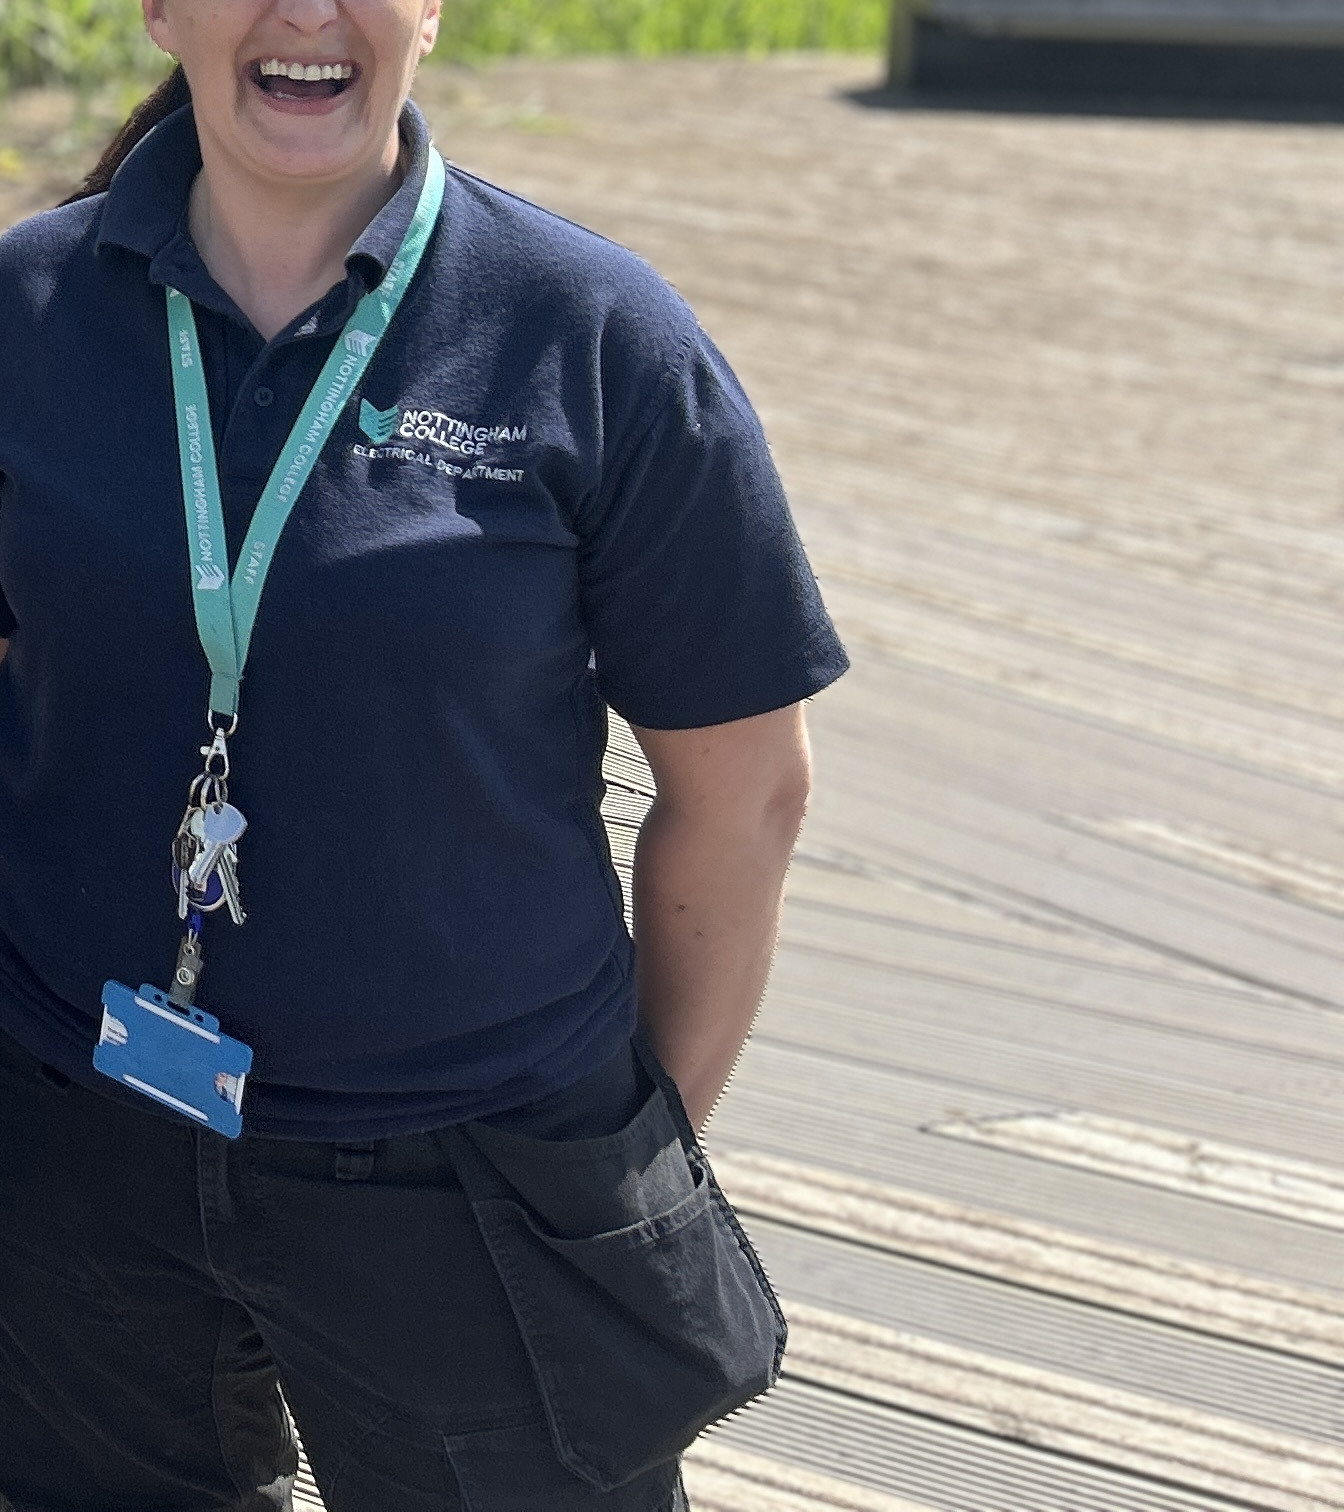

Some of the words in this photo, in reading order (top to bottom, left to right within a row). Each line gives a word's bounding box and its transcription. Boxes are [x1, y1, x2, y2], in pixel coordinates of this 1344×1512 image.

[179, 329, 194, 369] STAFF
[304, 353, 359, 444] NOTTINGHAM
[185, 403, 202, 464] COLLEGE
[399, 422, 488, 456] COLLEGE
[402, 410, 528, 442] NOTTINGHAM
[278, 443, 312, 503] COLLEGE
[353, 444, 433, 466] ELECTRICAL
[436, 459, 525, 483] DEPARTMENT
[190, 465, 213, 563] NOTTINGHAM
[244, 540, 266, 586] STAFF
